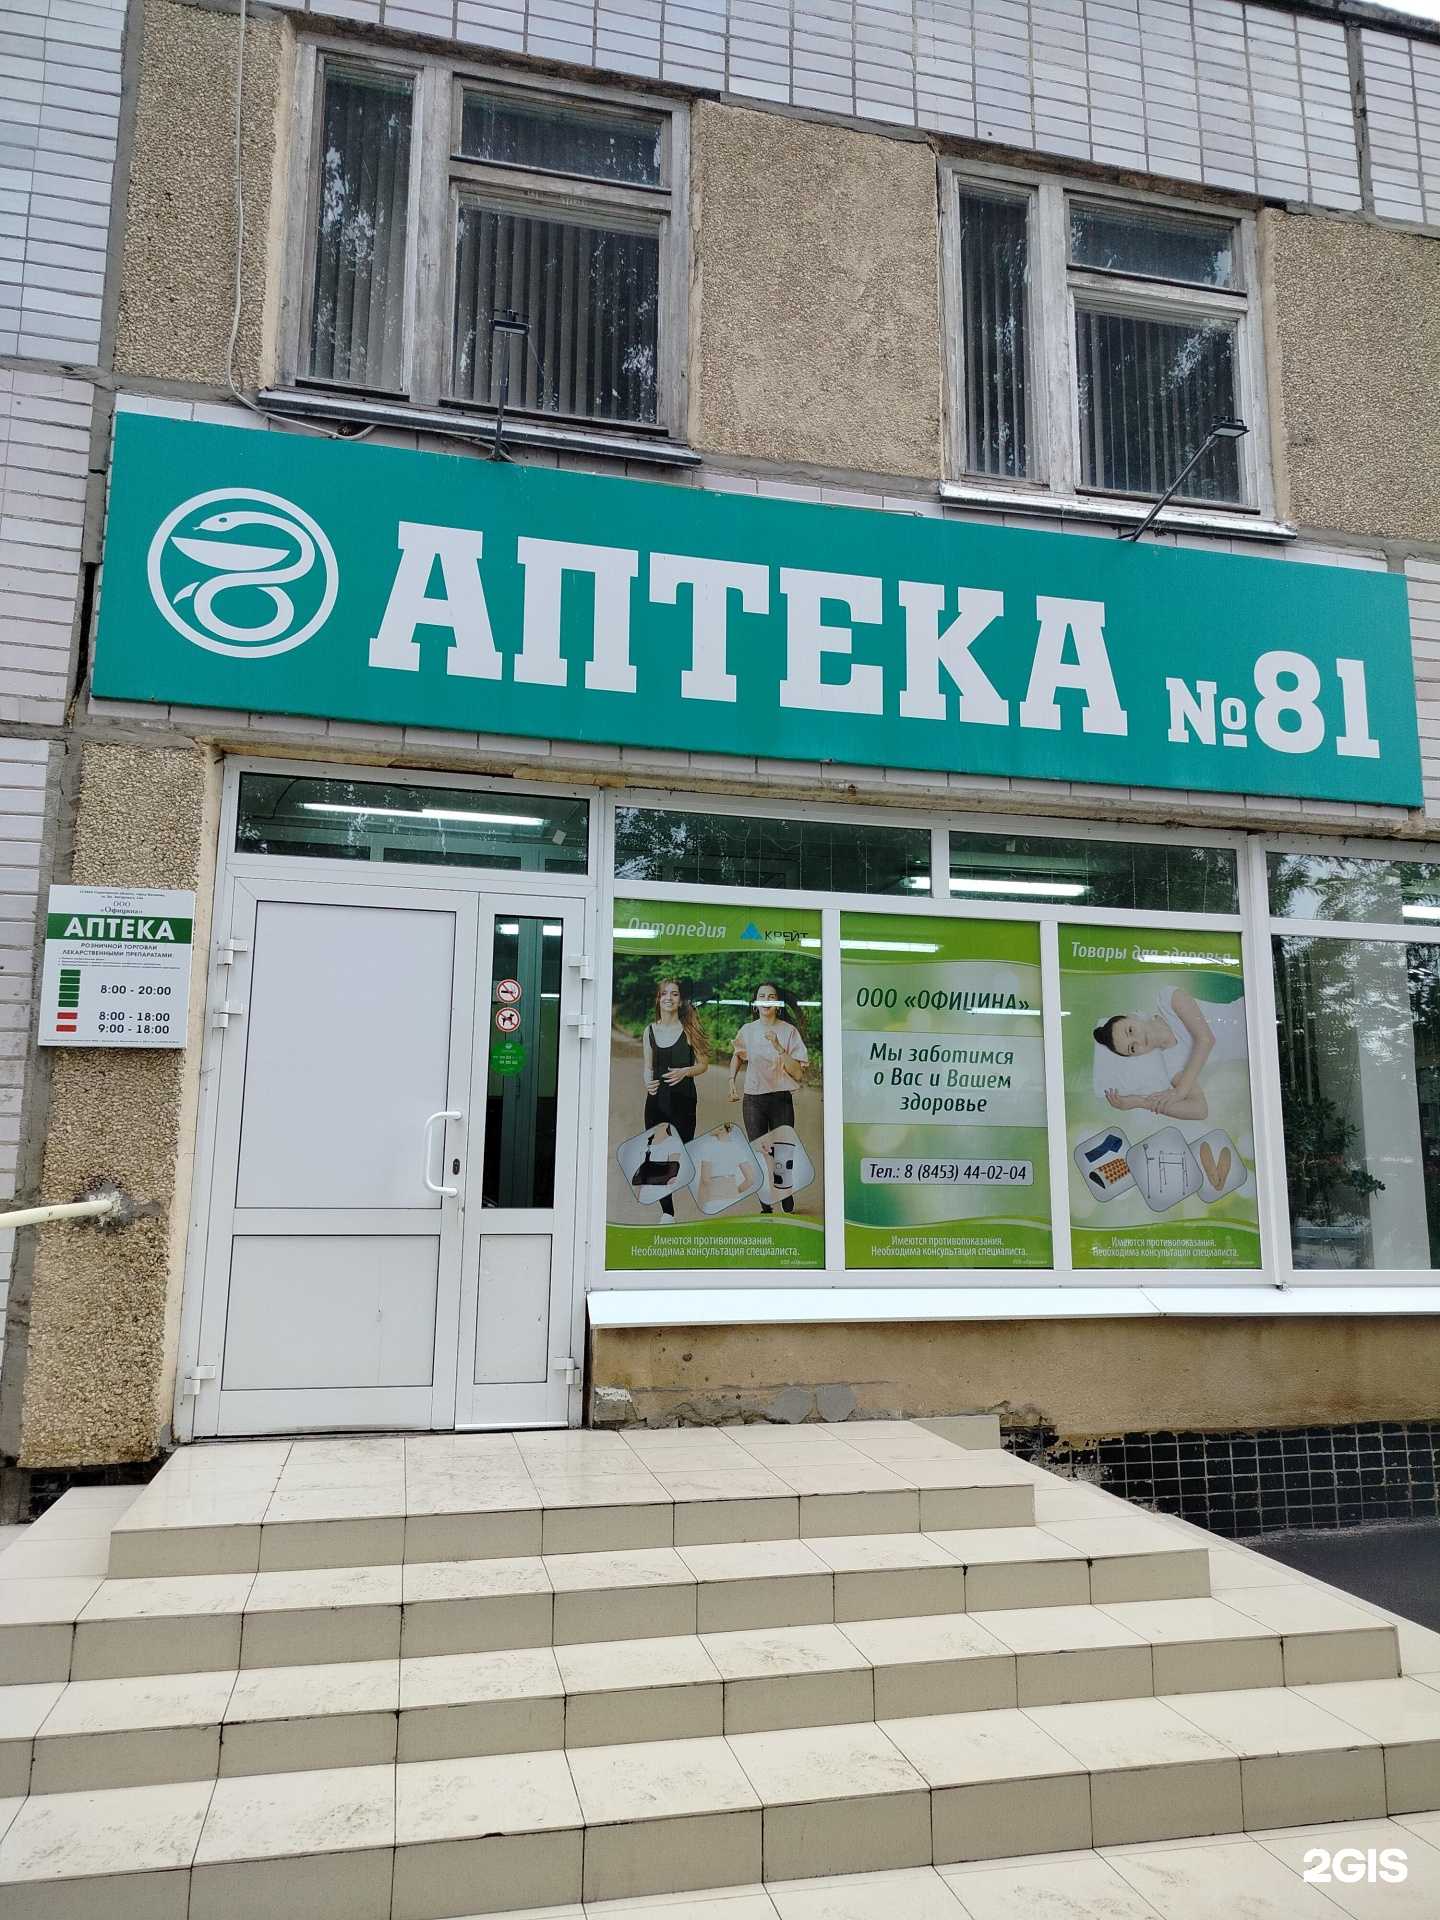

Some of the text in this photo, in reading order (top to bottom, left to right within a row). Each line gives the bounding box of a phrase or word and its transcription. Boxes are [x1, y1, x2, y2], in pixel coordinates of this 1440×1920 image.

[368, 521, 1381, 759] АПТЕКА №81
[63, 917, 175, 940] АПТЕКА
[62, 949, 124, 957] ЛЕКАРСТВЕННЫМИ
[1071, 941, 1127, 962] Товары
[100, 985, 126, 994] 8:00
[138, 986, 171, 995] 20:00
[856, 987, 1030, 1013] ООО «ОФИЦИНА»
[99, 1011, 125, 1021] 8:00
[137, 1012, 170, 1022] 18:00
[98, 1024, 124, 1033] 9:00
[136, 1024, 170, 1034] 18:00
[870, 1042, 1014, 1065] Мы заботимся
[873, 1067, 1011, 1089] о Вас и Вашем
[900, 1092, 987, 1115] здоровье
[870, 1163, 1026, 1181] Тел.: 8 (8453) 44-02-04
[654, 1235, 775, 1247] Имеются противопоказания.
[891, 1235, 927, 1246] Имеются
[1111, 1237, 1145, 1247] Имеются
[631, 1246, 801, 1258] Необходима консультация специалиста.
[871, 1246, 921, 1257] Необходима
[922, 1247, 977, 1258] консультация
[1141, 1248, 1191, 1258] консультация
